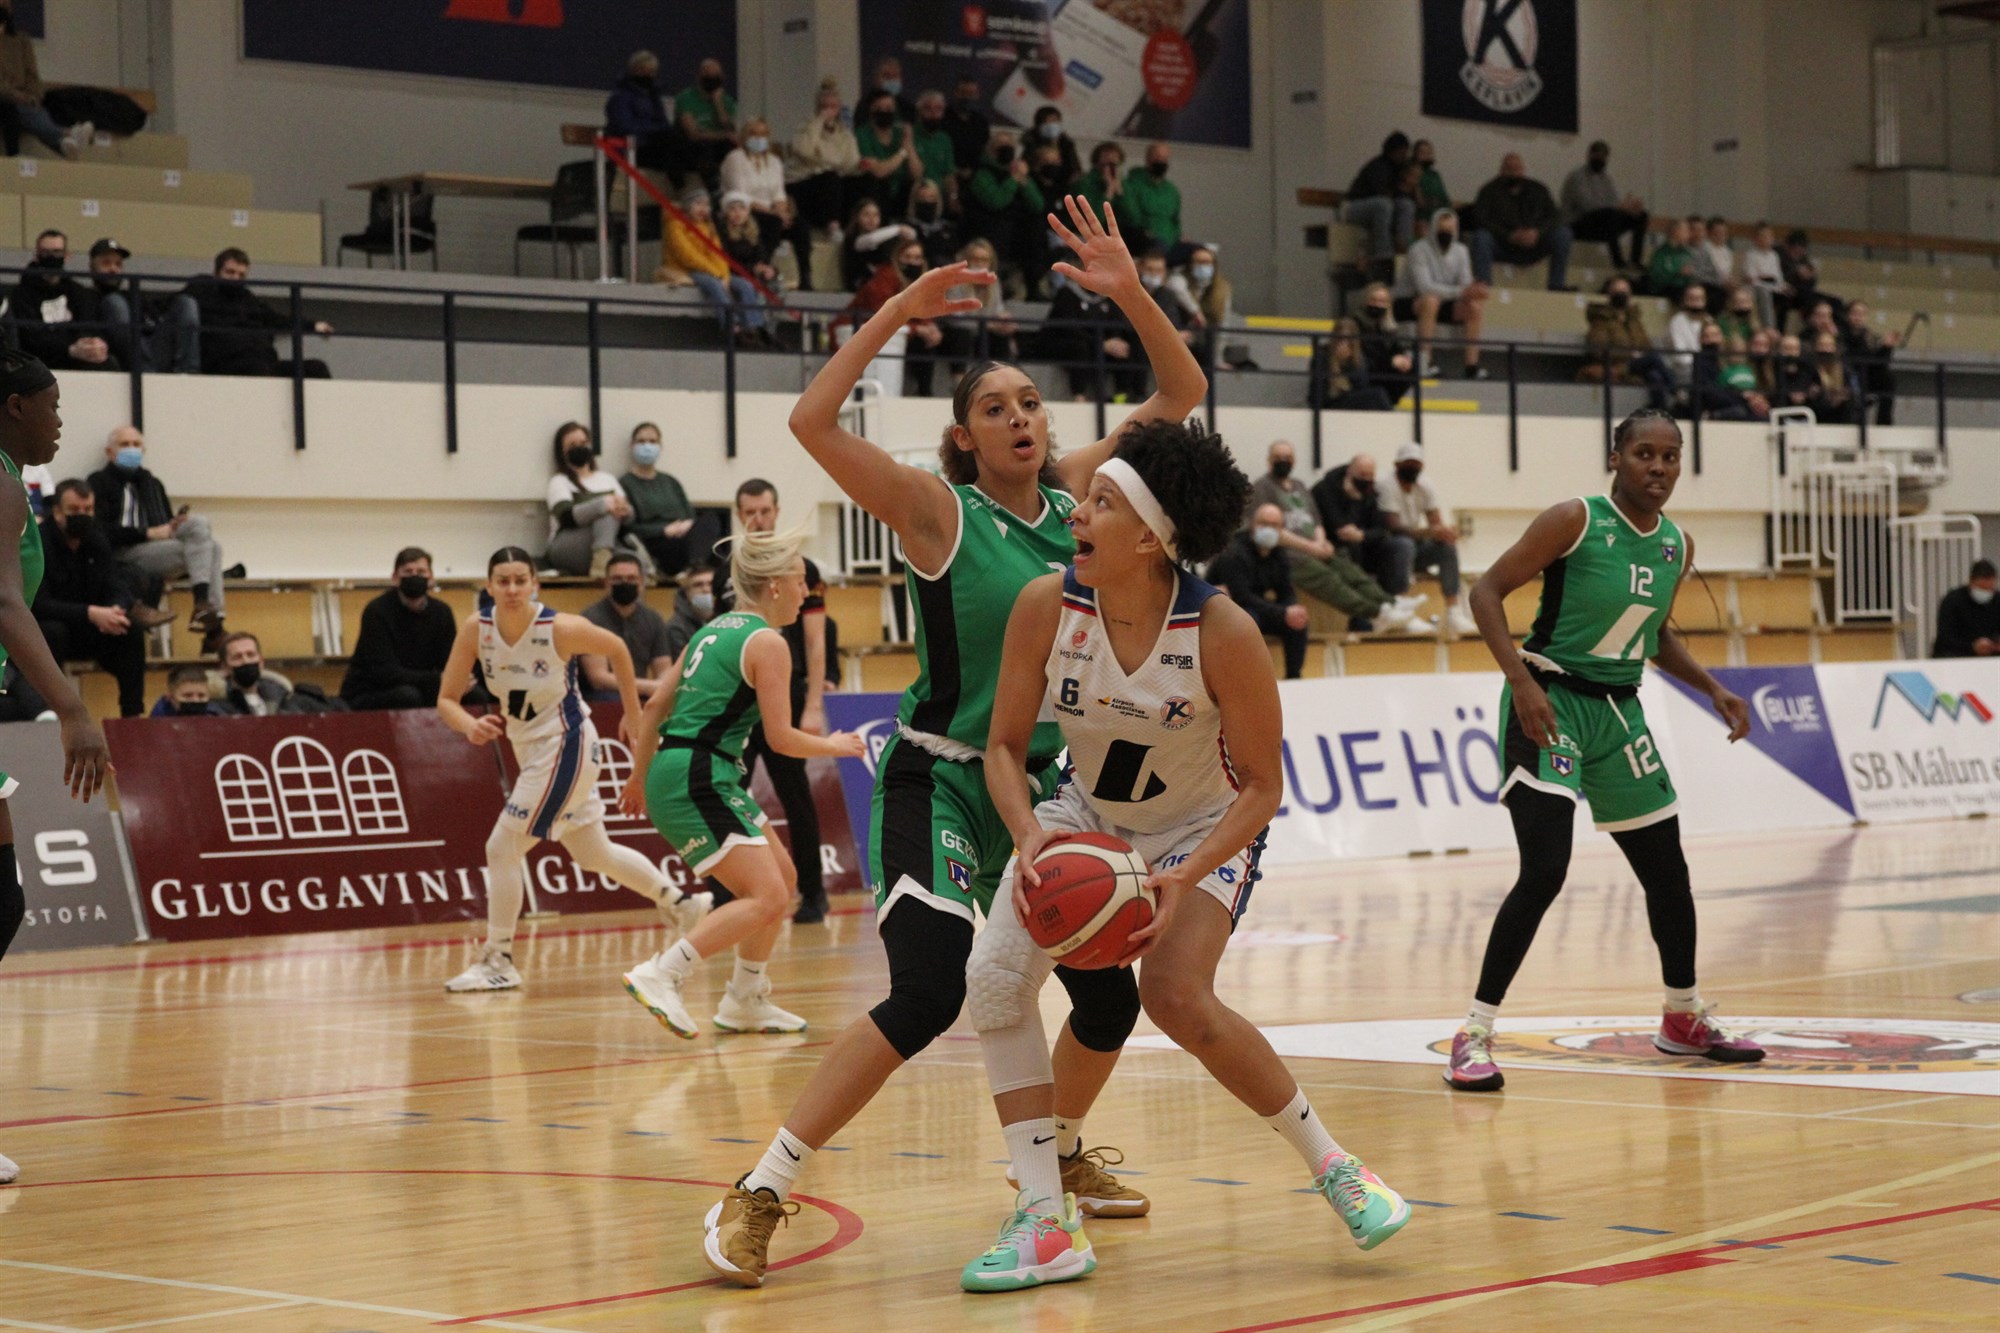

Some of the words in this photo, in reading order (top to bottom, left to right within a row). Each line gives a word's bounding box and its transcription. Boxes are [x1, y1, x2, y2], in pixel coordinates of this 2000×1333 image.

[1629, 563, 1654, 598] 12
[1060, 649, 1071, 660] HS
[1072, 651, 1094, 662] ORKA
[1160, 653, 1194, 666] GEYSIR
[1060, 677, 1080, 707] 6
[1111, 697, 1135, 708] Airport
[1054, 702, 1086, 717] HENSON
[1110, 703, 1146, 715] Associates
[1764, 695, 1821, 723] BLUE
[1623, 734, 1661, 780] 12
[1850, 751, 1894, 791] SB
[1037, 904, 1061, 926] FIBA
